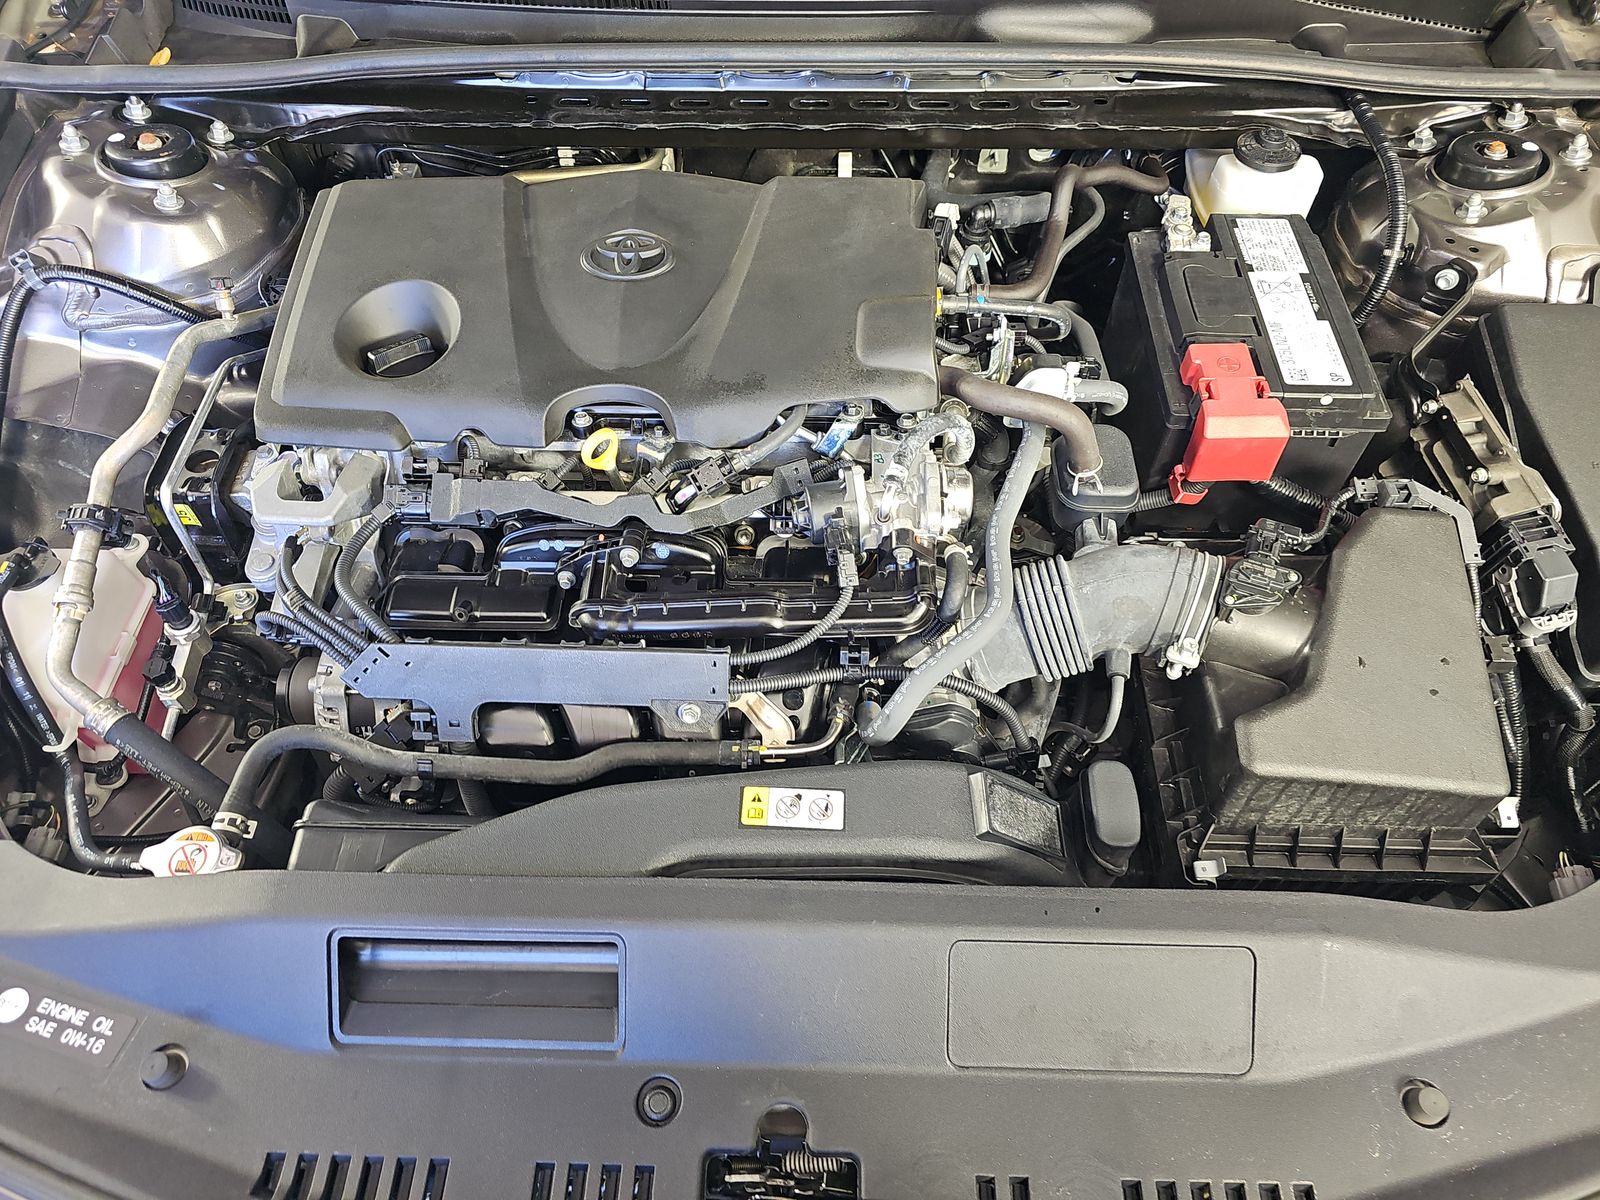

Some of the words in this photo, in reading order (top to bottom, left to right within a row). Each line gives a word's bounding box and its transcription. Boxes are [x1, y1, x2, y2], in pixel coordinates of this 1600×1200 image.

[24, 1015, 58, 1039] SAE
[59, 1027, 106, 1054] 0W-16
[36, 997, 90, 1026] ENGINE
[91, 1016, 114, 1036] OIL
